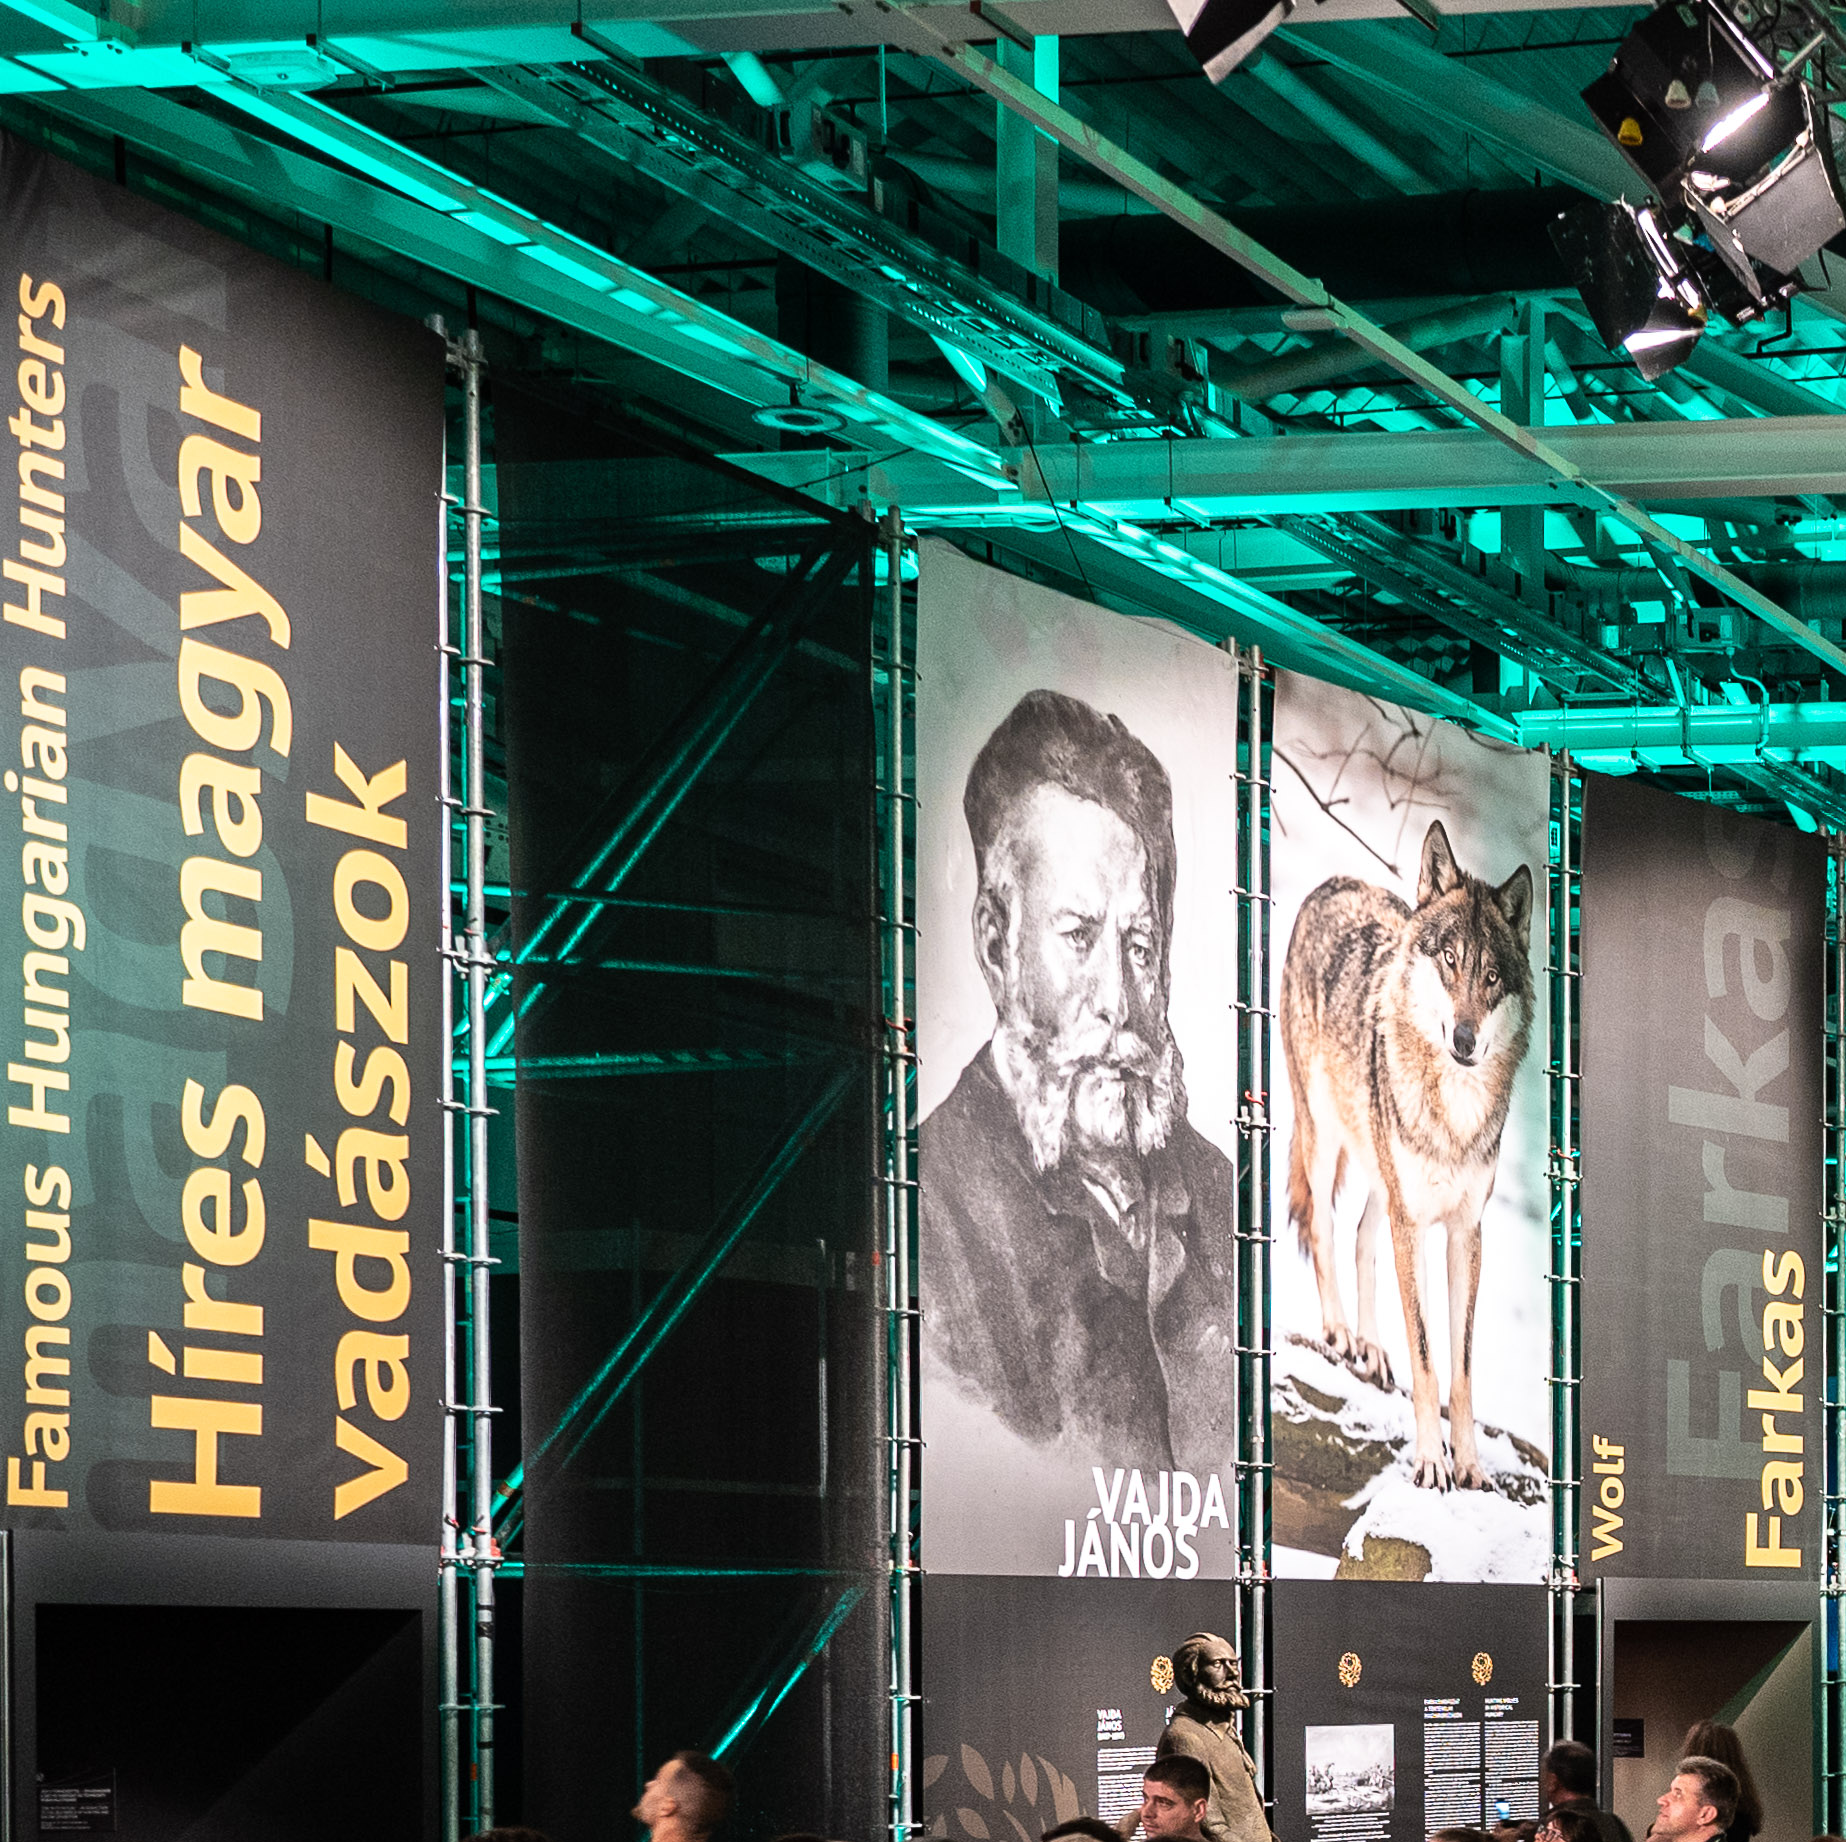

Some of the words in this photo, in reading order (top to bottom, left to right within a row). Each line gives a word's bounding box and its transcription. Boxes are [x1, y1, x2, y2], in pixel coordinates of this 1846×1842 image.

[2, 272, 68, 641] Hunters
[177, 343, 294, 1022] magyar
[3, 666, 87, 1134] Hungarian
[148, 1078, 267, 1520] Híres
[304, 741, 412, 1521] vadászok
[6, 1162, 72, 1508] Famous
[1092, 1466, 1230, 1529] VAJDA
[1590, 1433, 1626, 1563] Wolf
[1744, 1248, 1806, 1570] Farkas
[1058, 1507, 1200, 1580] JÁNOS
